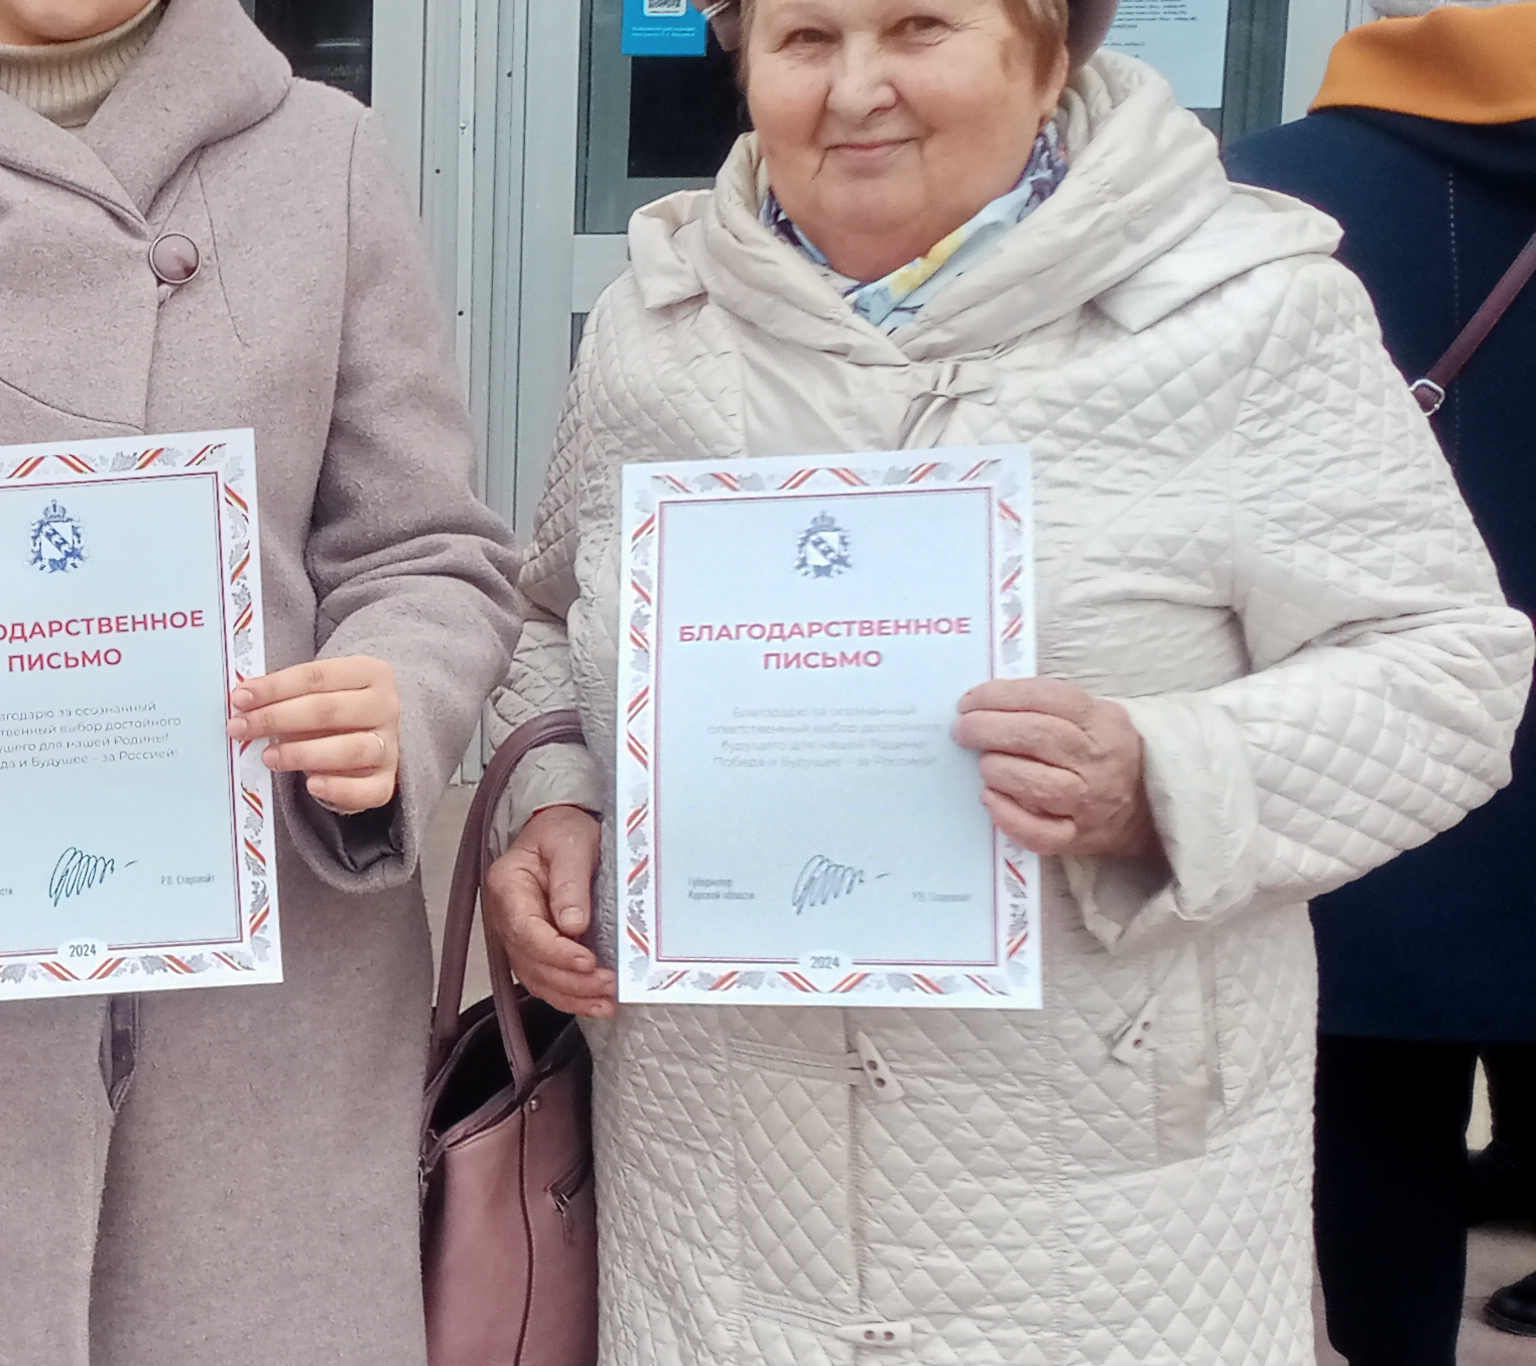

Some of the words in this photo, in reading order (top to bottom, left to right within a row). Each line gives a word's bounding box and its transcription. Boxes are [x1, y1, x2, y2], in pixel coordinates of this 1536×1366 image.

[678, 616, 971, 643] БЛАГОДАРСТВЕННОЕ
[7, 648, 122, 674] ПИСЬМО
[763, 649, 882, 671] ПИСЬМО
[105, 716, 182, 732] достойного
[68, 943, 97, 957] 2024
[810, 955, 841, 970] 2024
